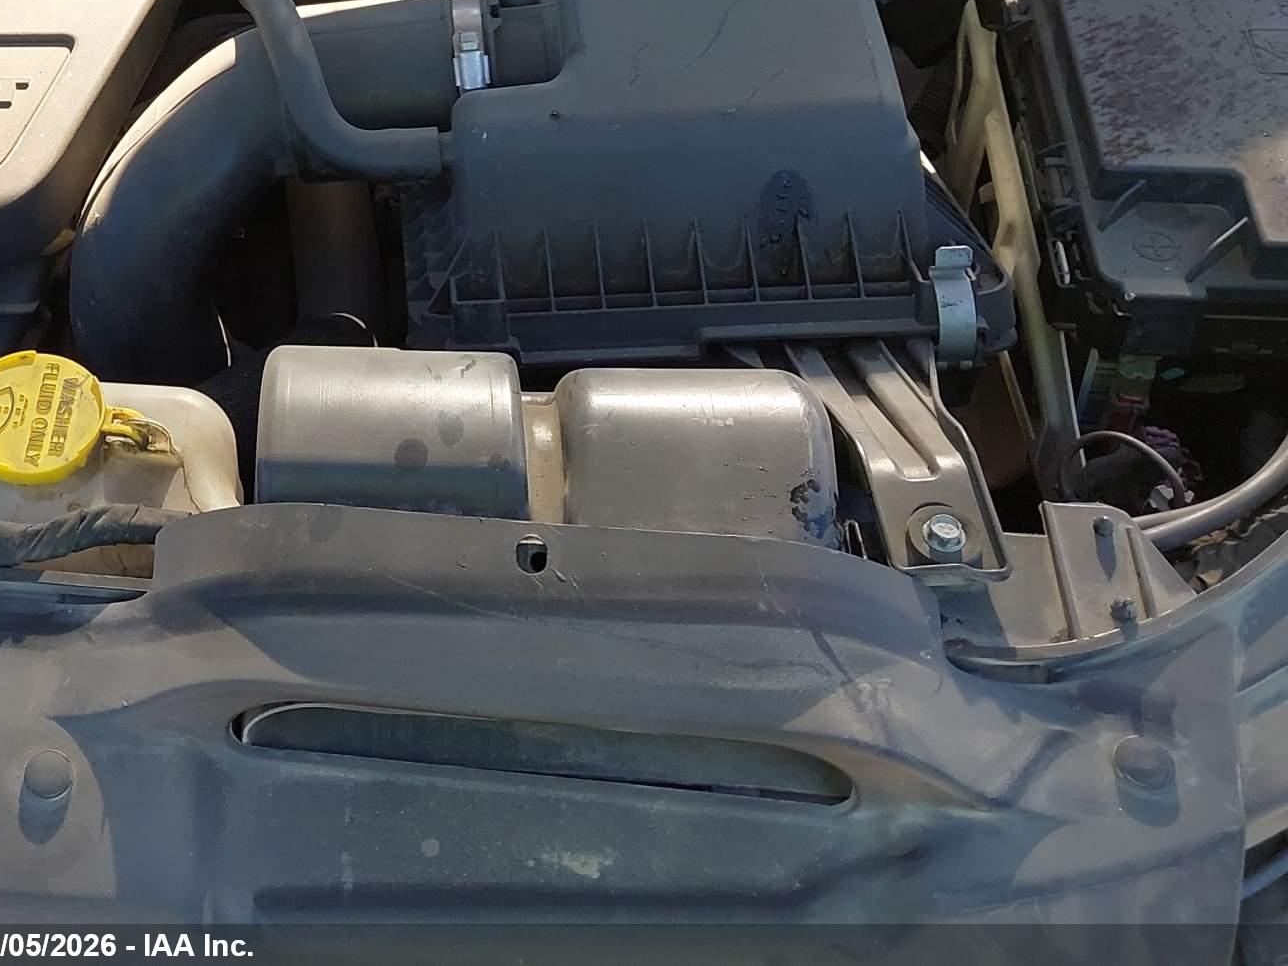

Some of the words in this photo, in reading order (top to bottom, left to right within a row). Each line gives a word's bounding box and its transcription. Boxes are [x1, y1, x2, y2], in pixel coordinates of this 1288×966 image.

[35, 362, 61, 415] FLUID
[23, 417, 49, 468] ONLY
[47, 377, 80, 459] WASHER
